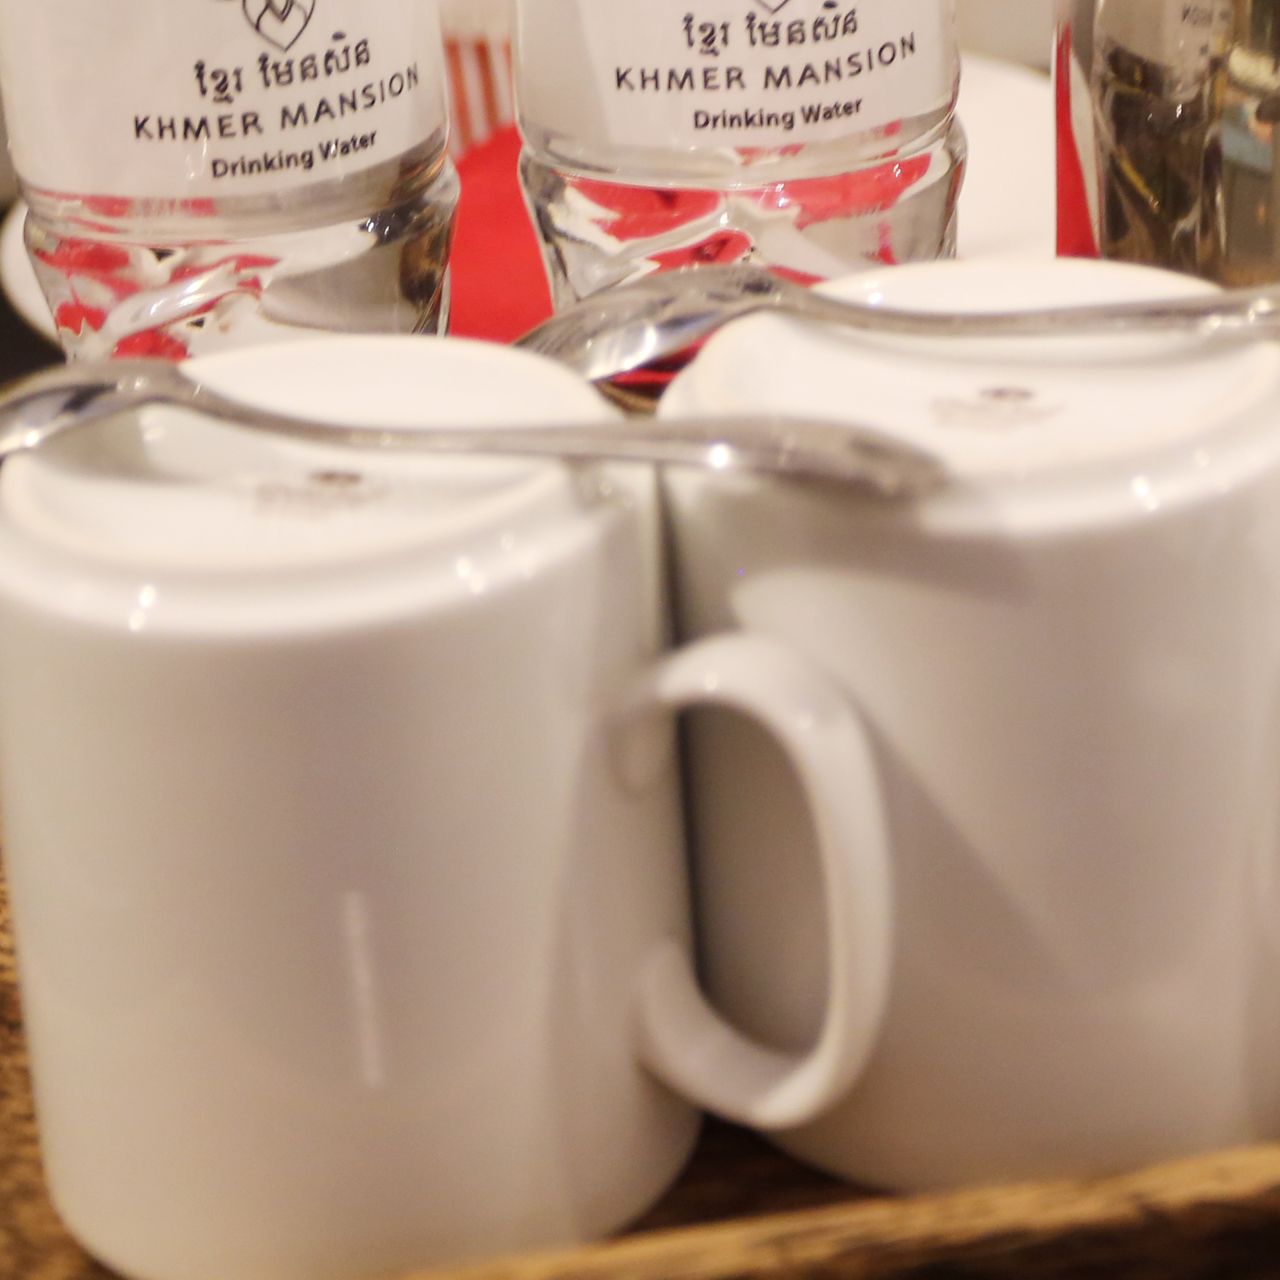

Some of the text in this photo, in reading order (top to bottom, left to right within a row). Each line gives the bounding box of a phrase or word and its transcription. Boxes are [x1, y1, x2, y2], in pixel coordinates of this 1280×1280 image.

[615, 31, 917, 91] KHMER MANSION
[133, 61, 420, 140] KHMER MANSION
[694, 97, 864, 131] Drinking Water
[211, 130, 378, 179] Drinking Water
